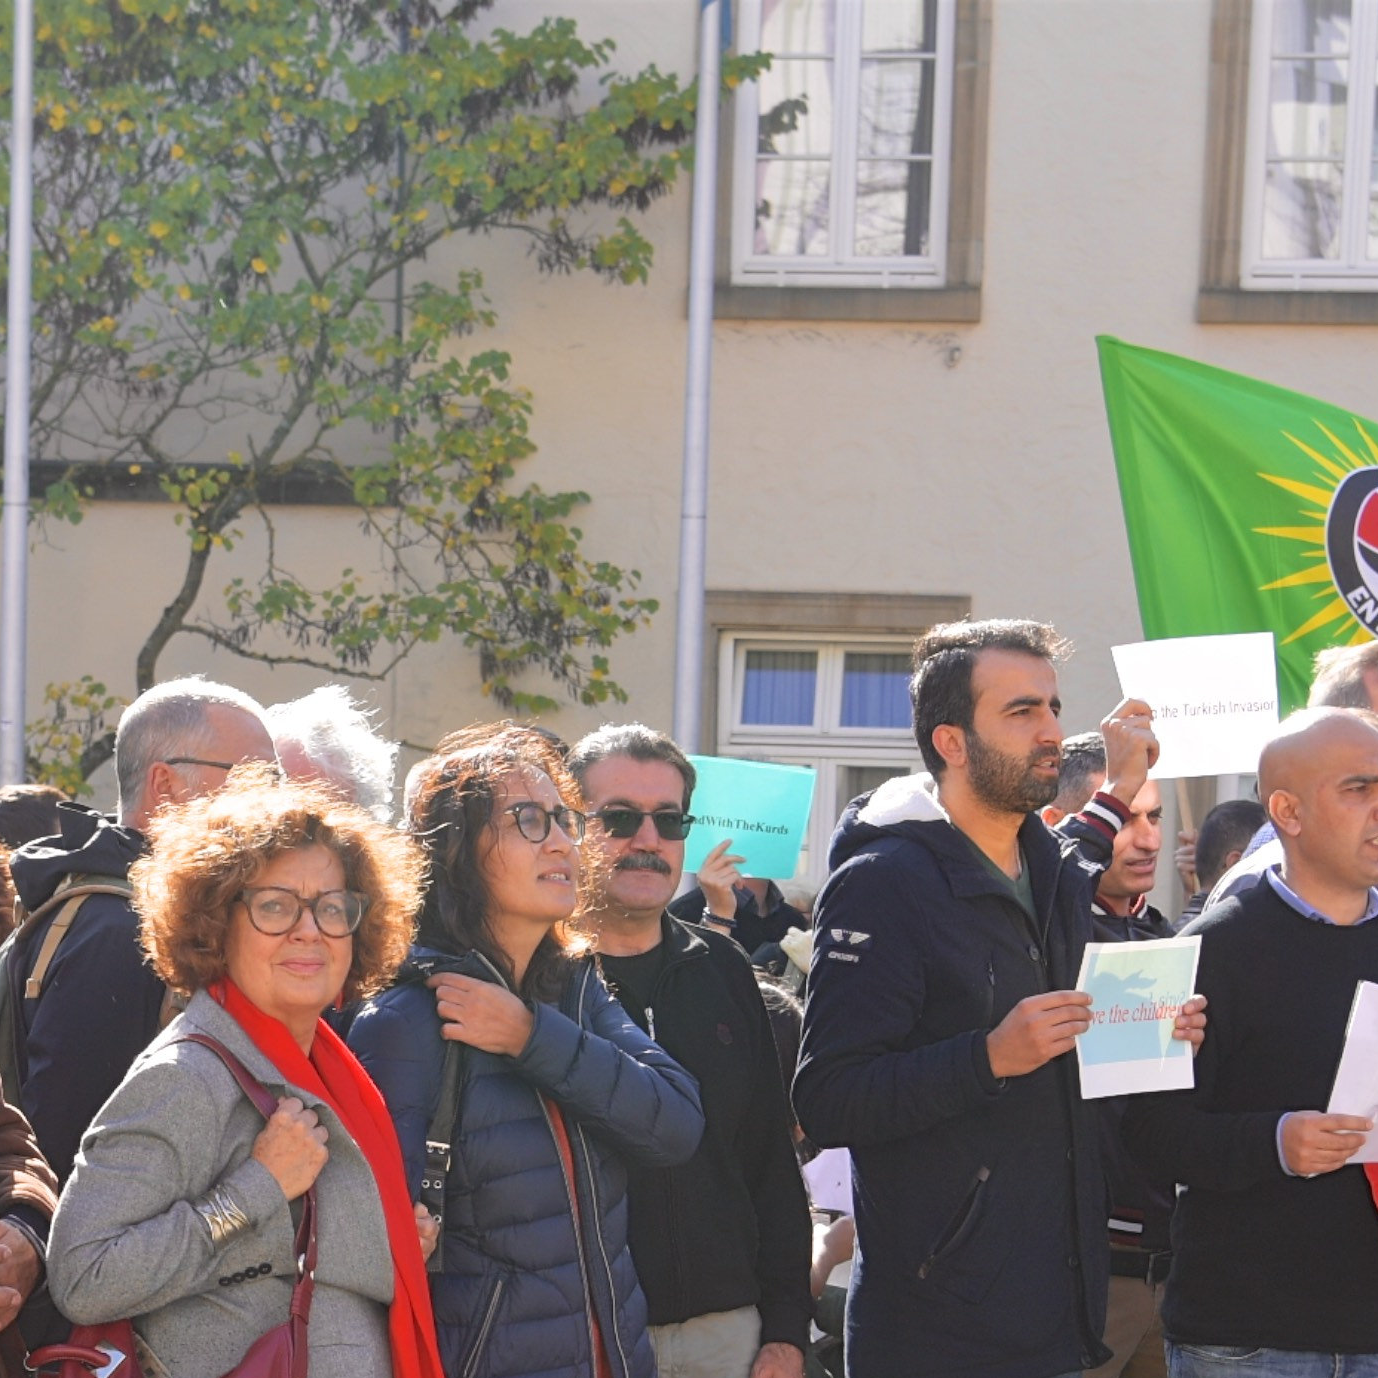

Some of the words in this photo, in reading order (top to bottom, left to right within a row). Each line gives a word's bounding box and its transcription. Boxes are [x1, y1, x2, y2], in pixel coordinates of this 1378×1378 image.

[1160, 705, 1178, 718] the
[1183, 701, 1226, 716] Turkish
[694, 815, 789, 835] ndWithTheKurds
[1092, 1009, 1105, 1025] ve
[1109, 1004, 1129, 1023] the
